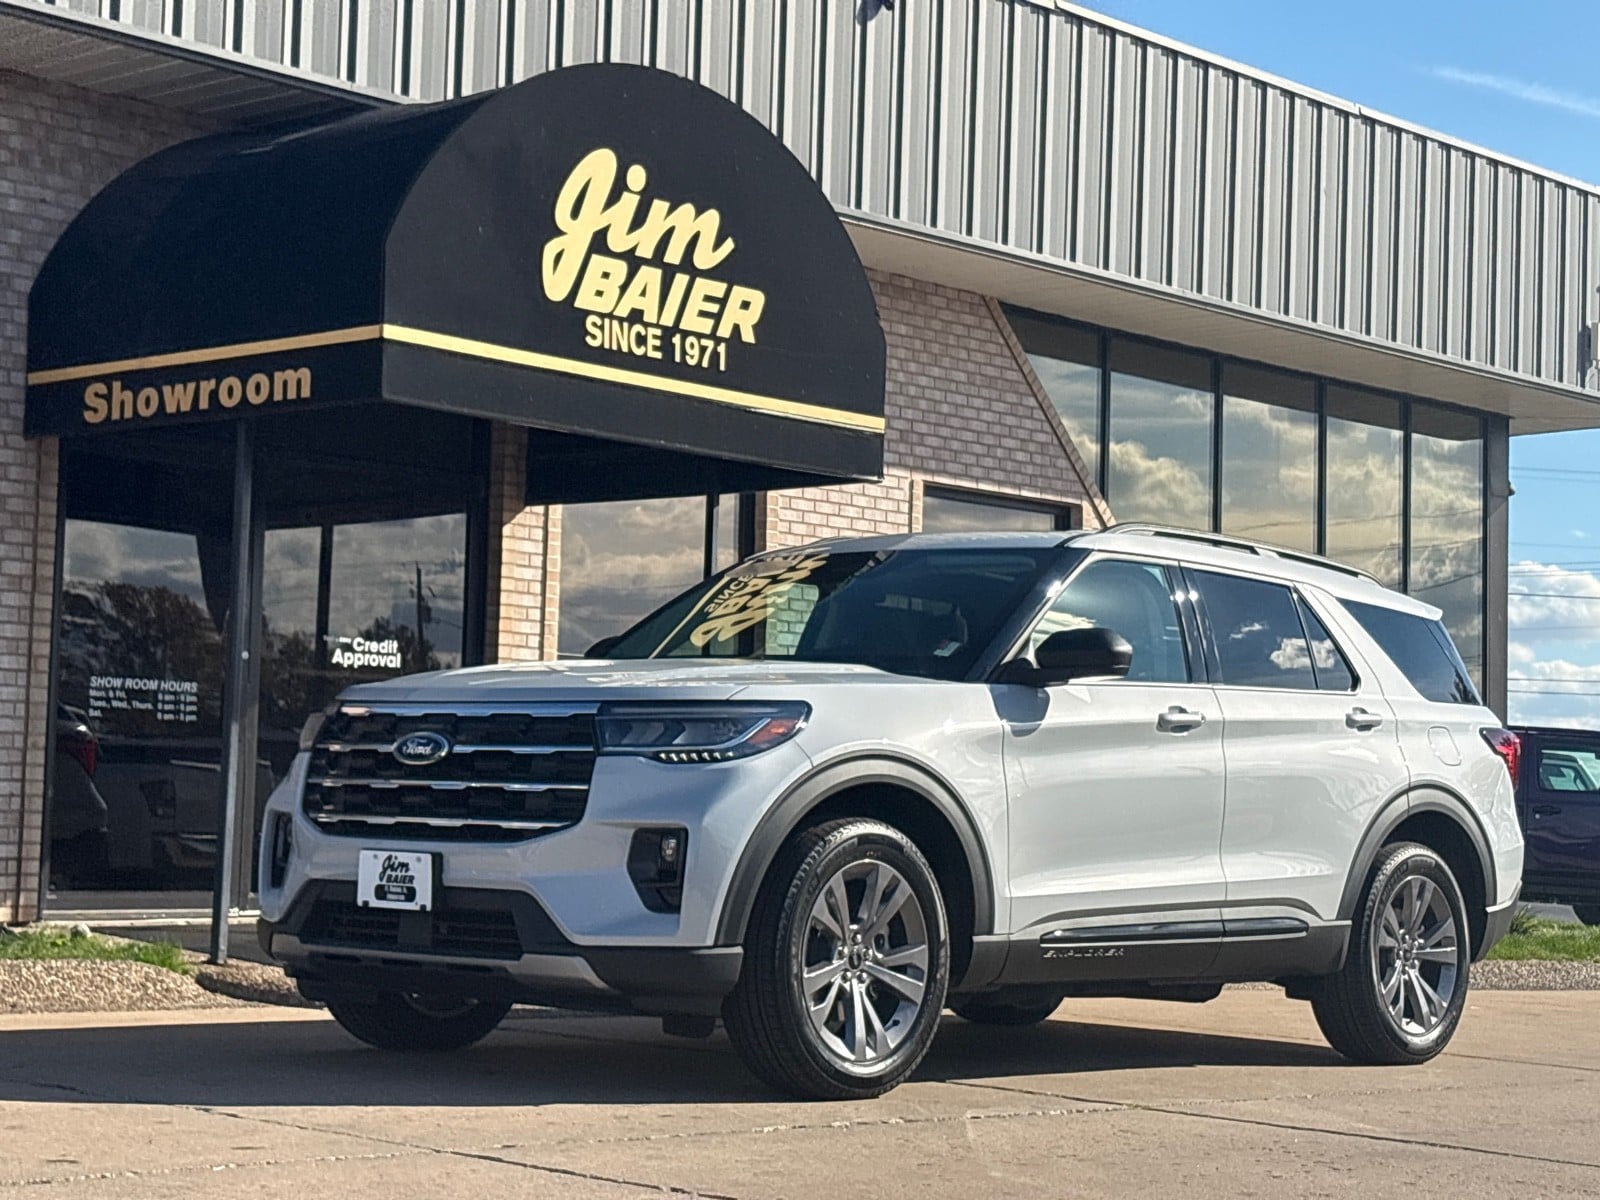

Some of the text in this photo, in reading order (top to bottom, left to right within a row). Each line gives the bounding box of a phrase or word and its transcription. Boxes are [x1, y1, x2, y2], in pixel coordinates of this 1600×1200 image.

[542, 148, 735, 302] Jim
[573, 253, 766, 344] BAIER
[585, 315, 727, 371] SINCE 1971
[83, 366, 311, 424] Showroom
[352, 637, 399, 654] Credit
[331, 648, 402, 669] Approval
[90, 676, 198, 693] SHOW ROOM HOURS
[402, 737, 434, 756] Ford
[379, 854, 410, 882] Jim
[386, 874, 415, 885] BAIER
